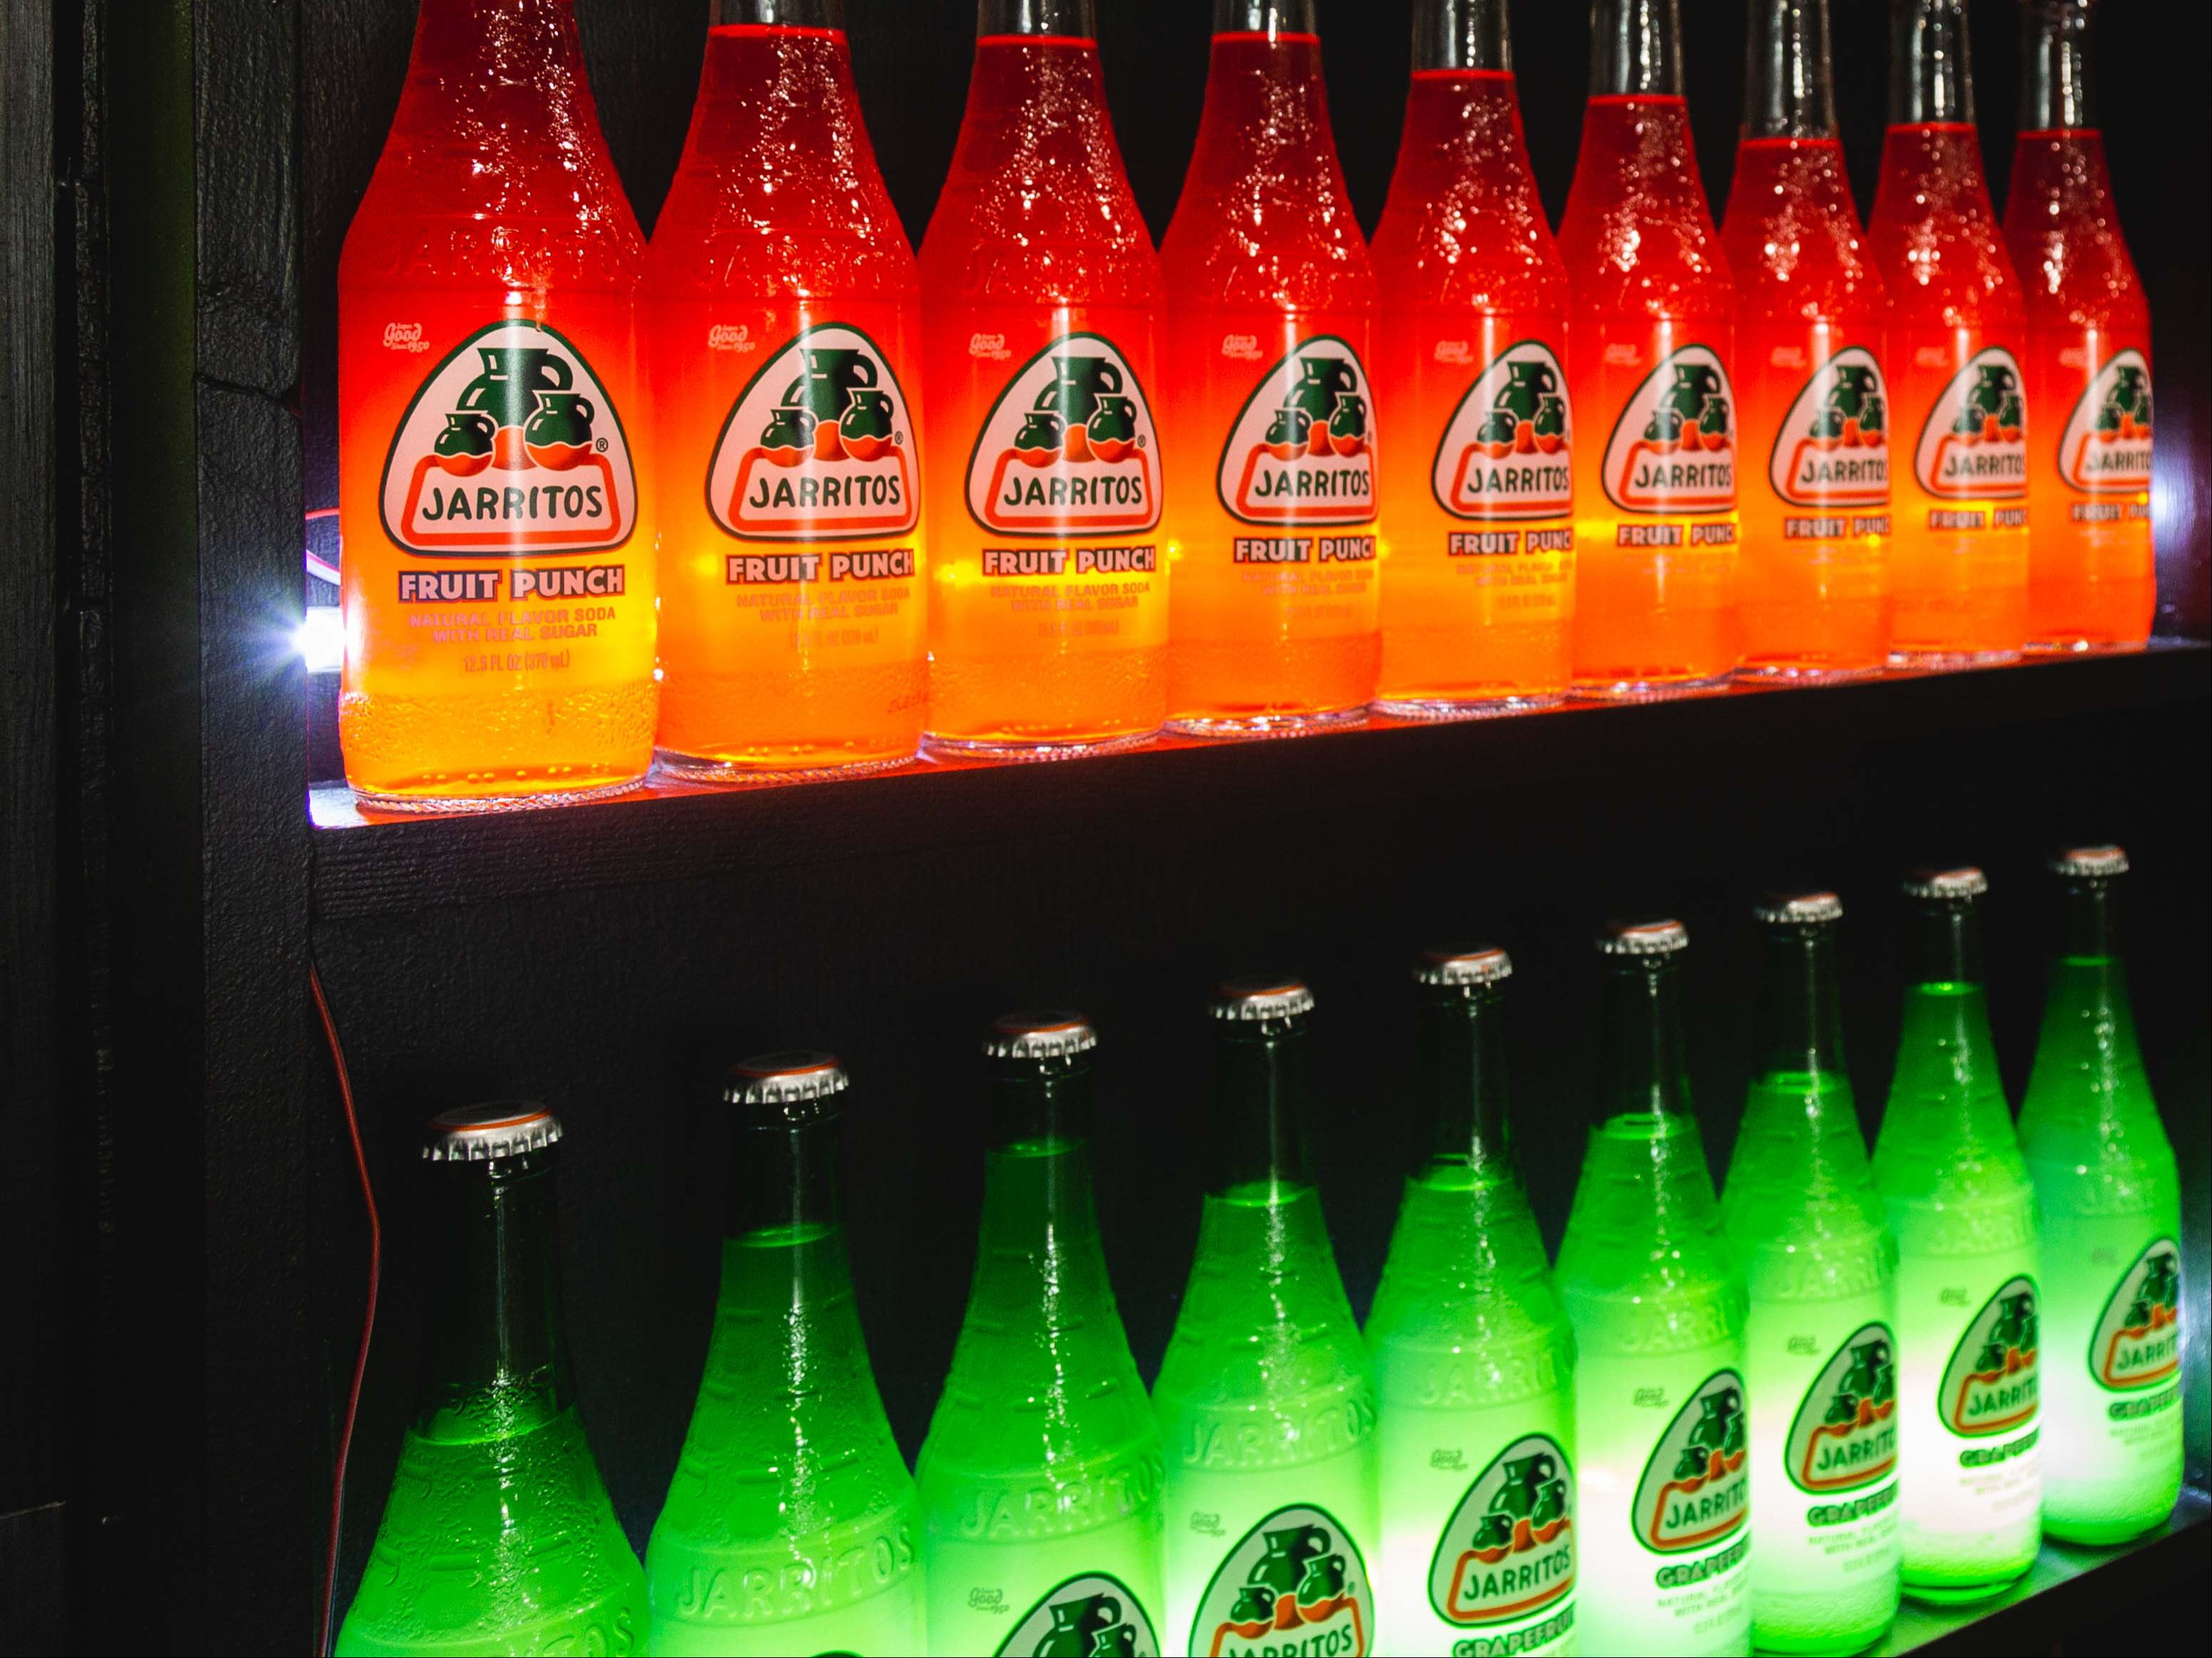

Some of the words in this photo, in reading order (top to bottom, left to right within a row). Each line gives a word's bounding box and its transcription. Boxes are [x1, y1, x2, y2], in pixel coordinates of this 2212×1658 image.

[749, 474, 901, 508] JARRITOS
[1003, 476, 1142, 506] JARRITOS
[1255, 469, 1369, 497] JARRITOS
[422, 485, 603, 521] JARRITOS
[1234, 536, 1313, 563] FRUIT
[1449, 531, 1520, 556] FRUIT
[1617, 524, 1684, 547] FRUIT
[727, 554, 821, 584] FRUIT
[829, 550, 915, 581] PUNCH
[983, 549, 1069, 575] FRUIT
[1076, 546, 1156, 574] PUNCH
[398, 570, 502, 603] FRUIT
[511, 565, 625, 601] PUNCH
[409, 611, 491, 628] NATURAL
[499, 609, 569, 626] FLAVOR
[574, 606, 615, 622] SODA
[432, 628, 485, 643] WITH
[486, 626, 534, 642] REAL
[540, 623, 598, 640] SUGAR
[507, 652, 523, 671] OZ
[1464, 1544, 1571, 1600] JARRITOS
